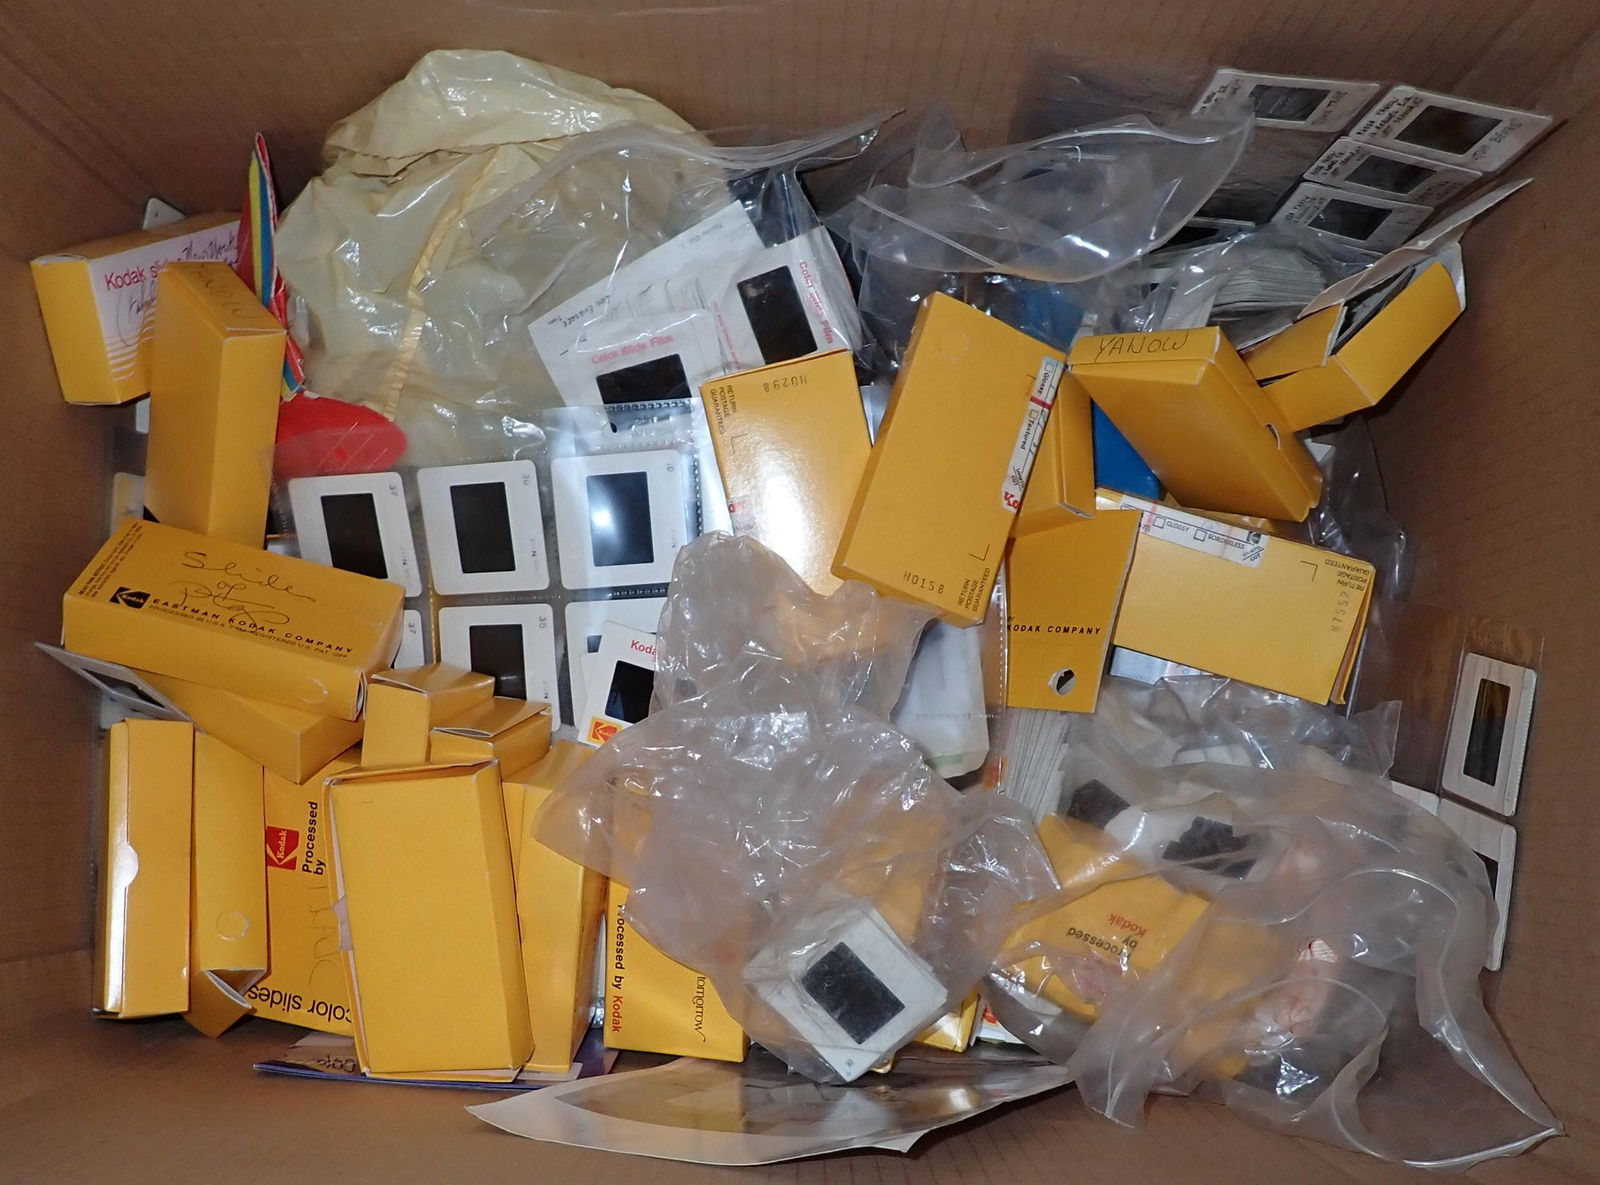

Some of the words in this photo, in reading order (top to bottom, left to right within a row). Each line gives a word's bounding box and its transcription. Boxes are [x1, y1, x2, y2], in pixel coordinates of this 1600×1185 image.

[104, 266, 147, 291] Kodak
[651, 334, 675, 349] Film
[820, 319, 834, 344] Film
[1094, 328, 1190, 364] YANOW
[1037, 372, 1050, 395] Glossy
[1021, 419, 1035, 451] Textured
[1166, 520, 1190, 533] GLOSSY
[1324, 558, 1370, 575] GUARANTEED
[958, 579, 970, 606] RETURN
[965, 579, 979, 609] POSTAGE
[972, 567, 990, 612] GUARANTEED
[152, 598, 221, 619] EASTMAN
[228, 616, 277, 634] KODAK
[285, 632, 353, 654] COMPANY
[1007, 624, 1041, 633] KODAK
[1047, 625, 1102, 635] COMPANY
[630, 640, 657, 656] Koda
[276, 829, 287, 859] Kodak
[301, 801, 318, 873] Processed
[313, 859, 327, 876] by
[1109, 913, 1147, 937] Kodak
[1121, 936, 1139, 950] by
[611, 975, 625, 990] by
[247, 984, 303, 1013] slides
[611, 995, 624, 1032] Kodak
